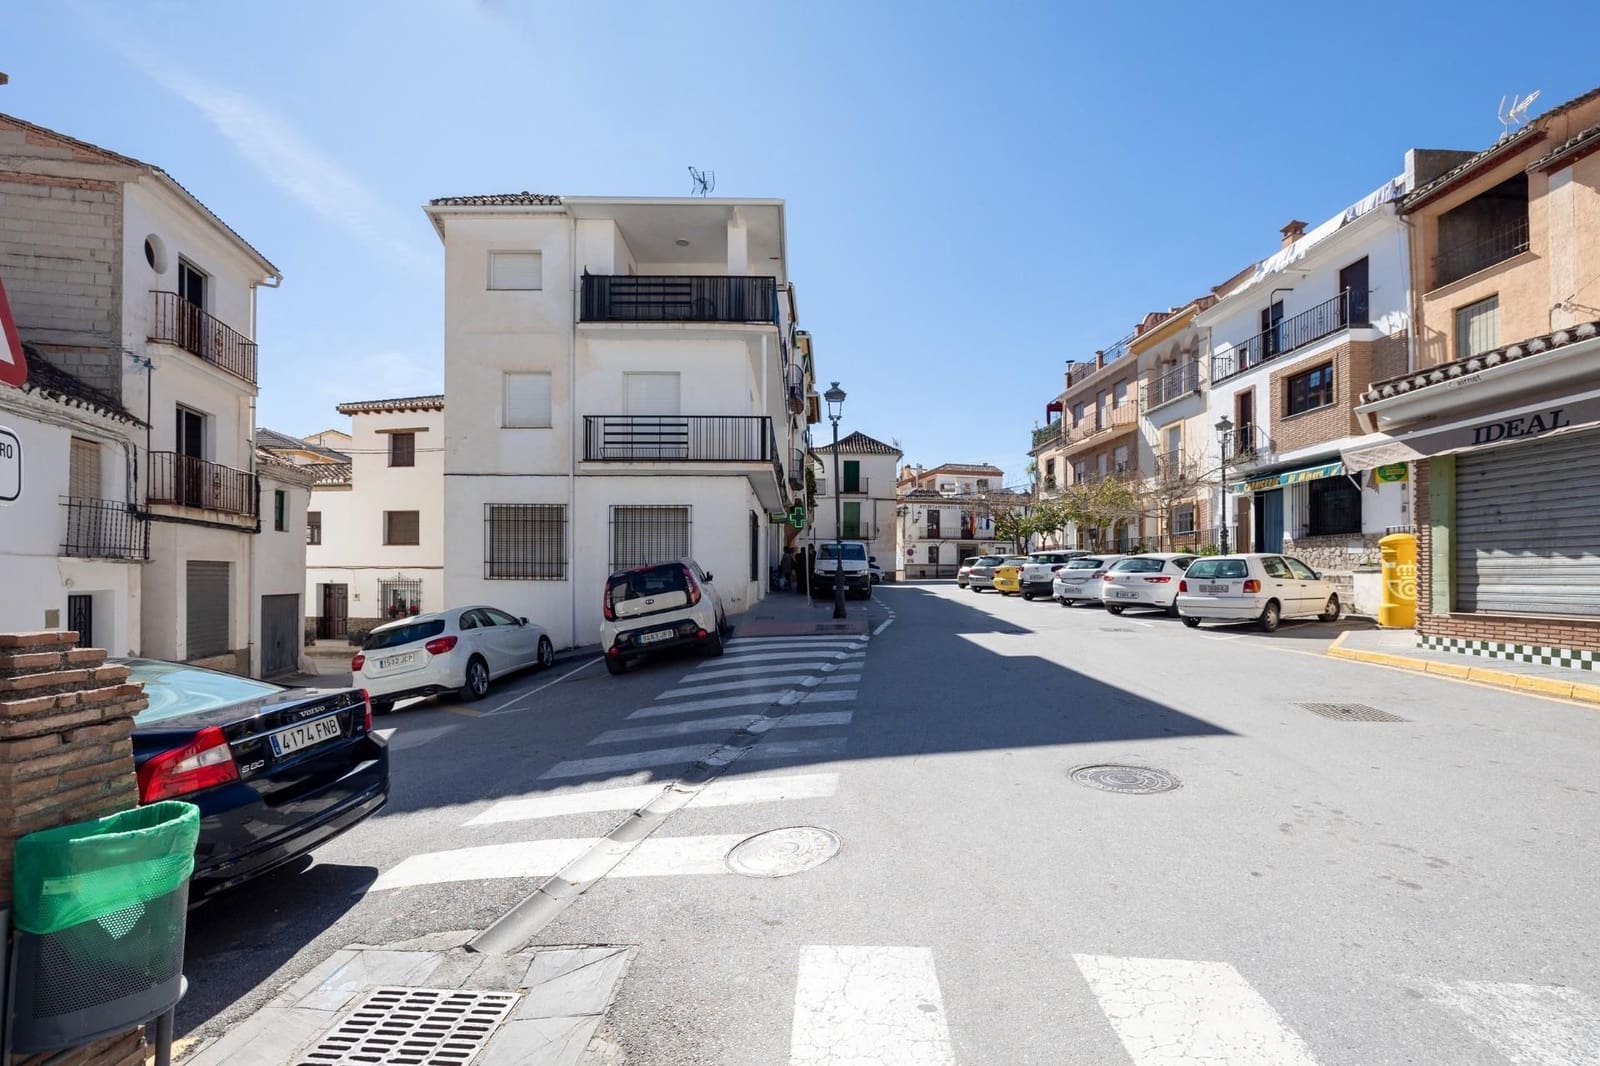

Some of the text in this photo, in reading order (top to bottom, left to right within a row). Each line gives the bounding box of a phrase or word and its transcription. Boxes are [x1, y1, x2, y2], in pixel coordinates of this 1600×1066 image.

[1472, 409, 1569, 445] IDEAL
[282, 718, 338, 750] 4174 FNB
